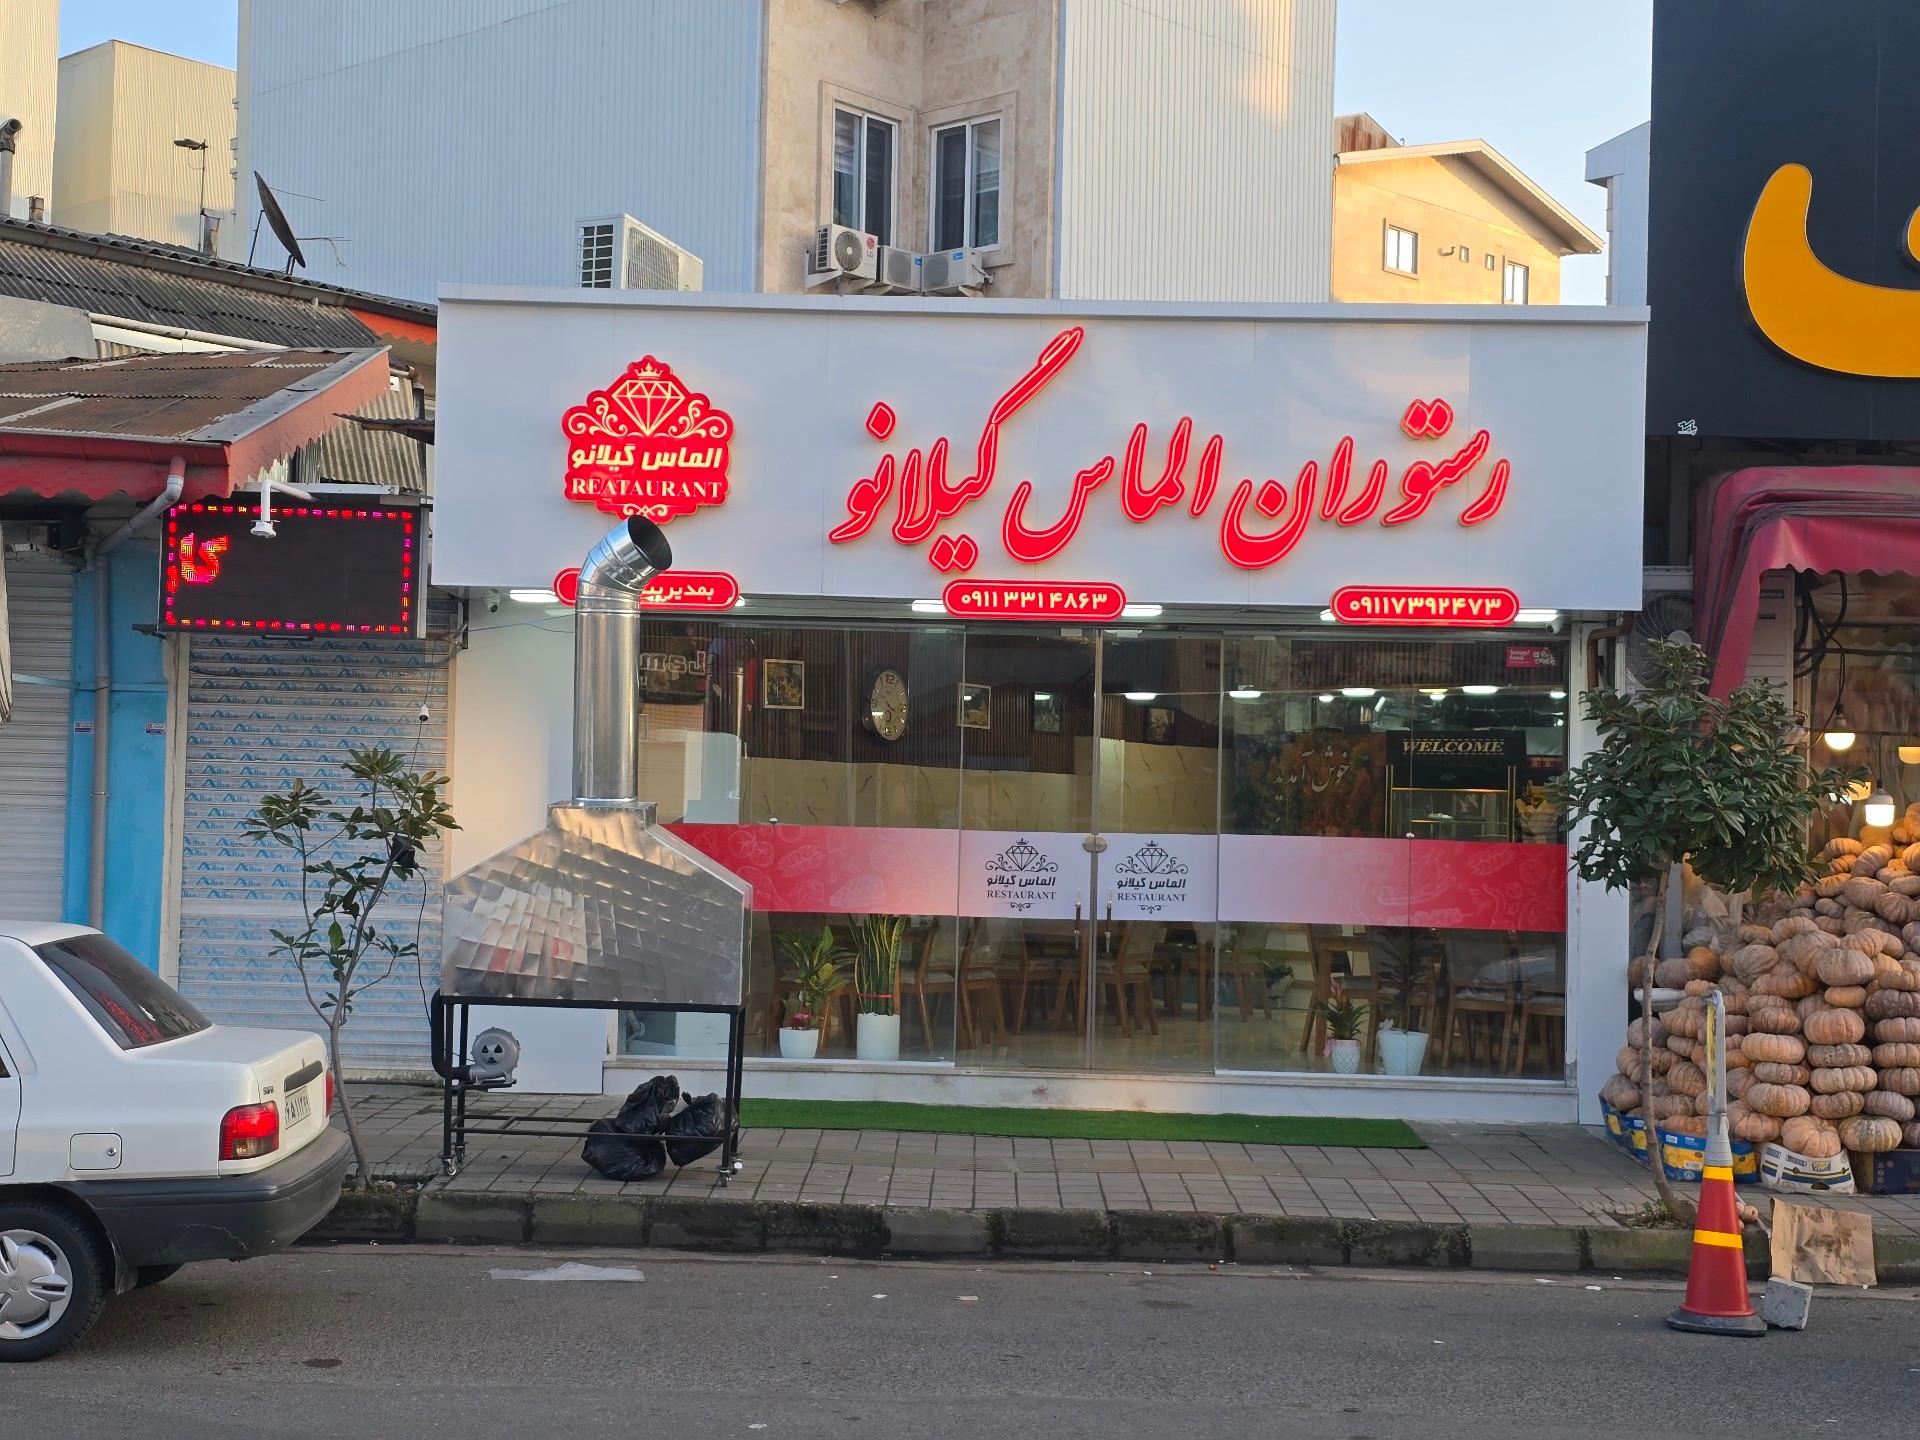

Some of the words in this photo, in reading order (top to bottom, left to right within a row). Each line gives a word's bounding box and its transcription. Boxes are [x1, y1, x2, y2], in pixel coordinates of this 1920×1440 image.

[571, 443, 636, 472] گیلانو
[828, 326, 1084, 573] گیلانو
[641, 447, 723, 471] الماس
[571, 477, 723, 499] REATAURANT
[1001, 415, 1223, 564] الماس
[1219, 398, 1510, 570] رستوران
[641, 584, 715, 602] بمدیری
[1402, 741, 1505, 753] WELCOME
[1311, 745, 1350, 793] خوش
[986, 875, 1016, 887] گیلانو
[1018, 876, 1056, 887] الماس
[1116, 877, 1146, 890] گیلانو
[1148, 878, 1187, 890] الماس
[986, 889, 1056, 900] RESTAURANT
[1117, 892, 1187, 902] RESTAURANT
